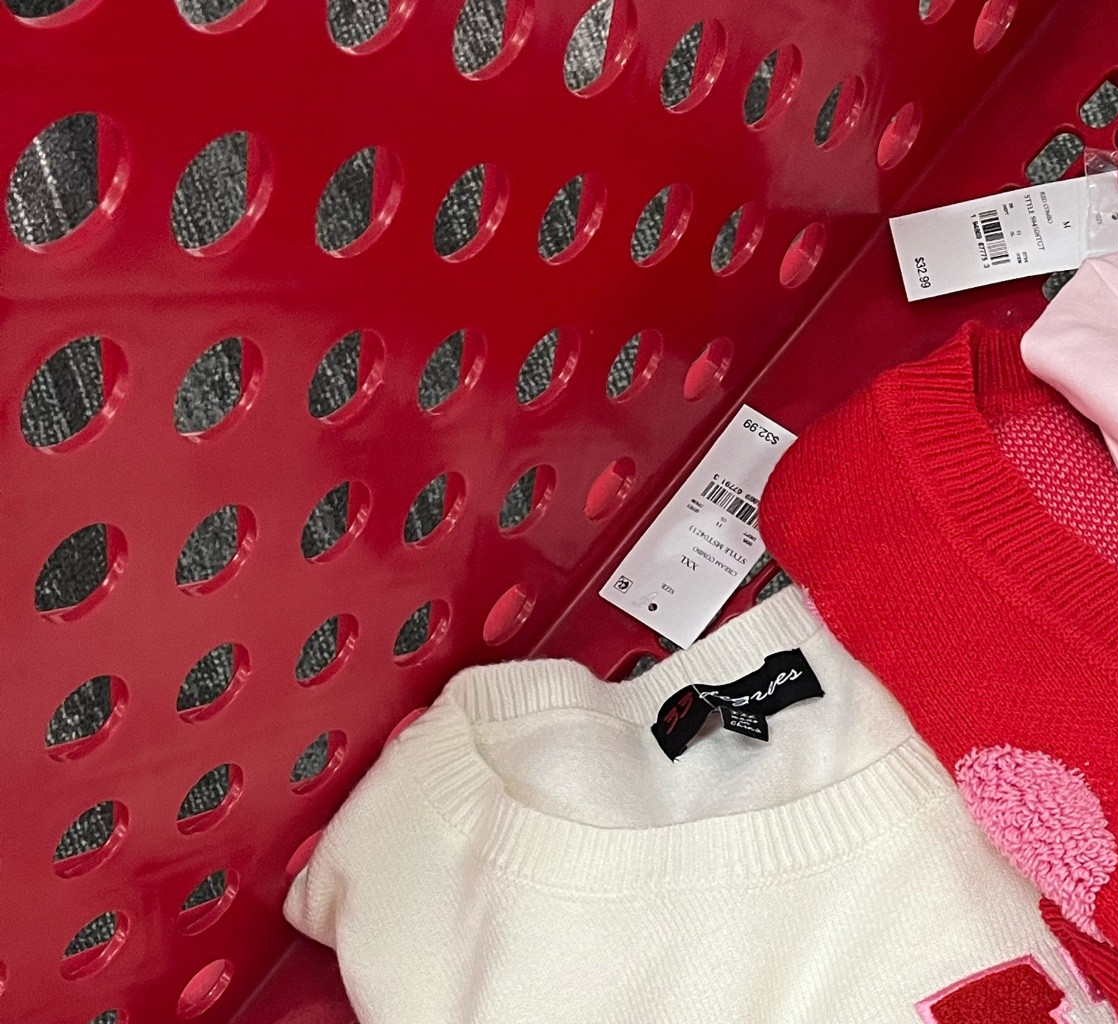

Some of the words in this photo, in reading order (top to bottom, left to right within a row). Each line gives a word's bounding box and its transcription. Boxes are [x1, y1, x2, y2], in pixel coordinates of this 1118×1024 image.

[1024, 194, 1035, 214] STYLE
[914, 257, 931, 288] $32.99
[743, 419, 780, 445] $32.99
[681, 554, 700, 572] XXL
[725, 547, 747, 564] STYLE
[715, 560, 737, 576] CREAM
[661, 583, 675, 594] SIZE
